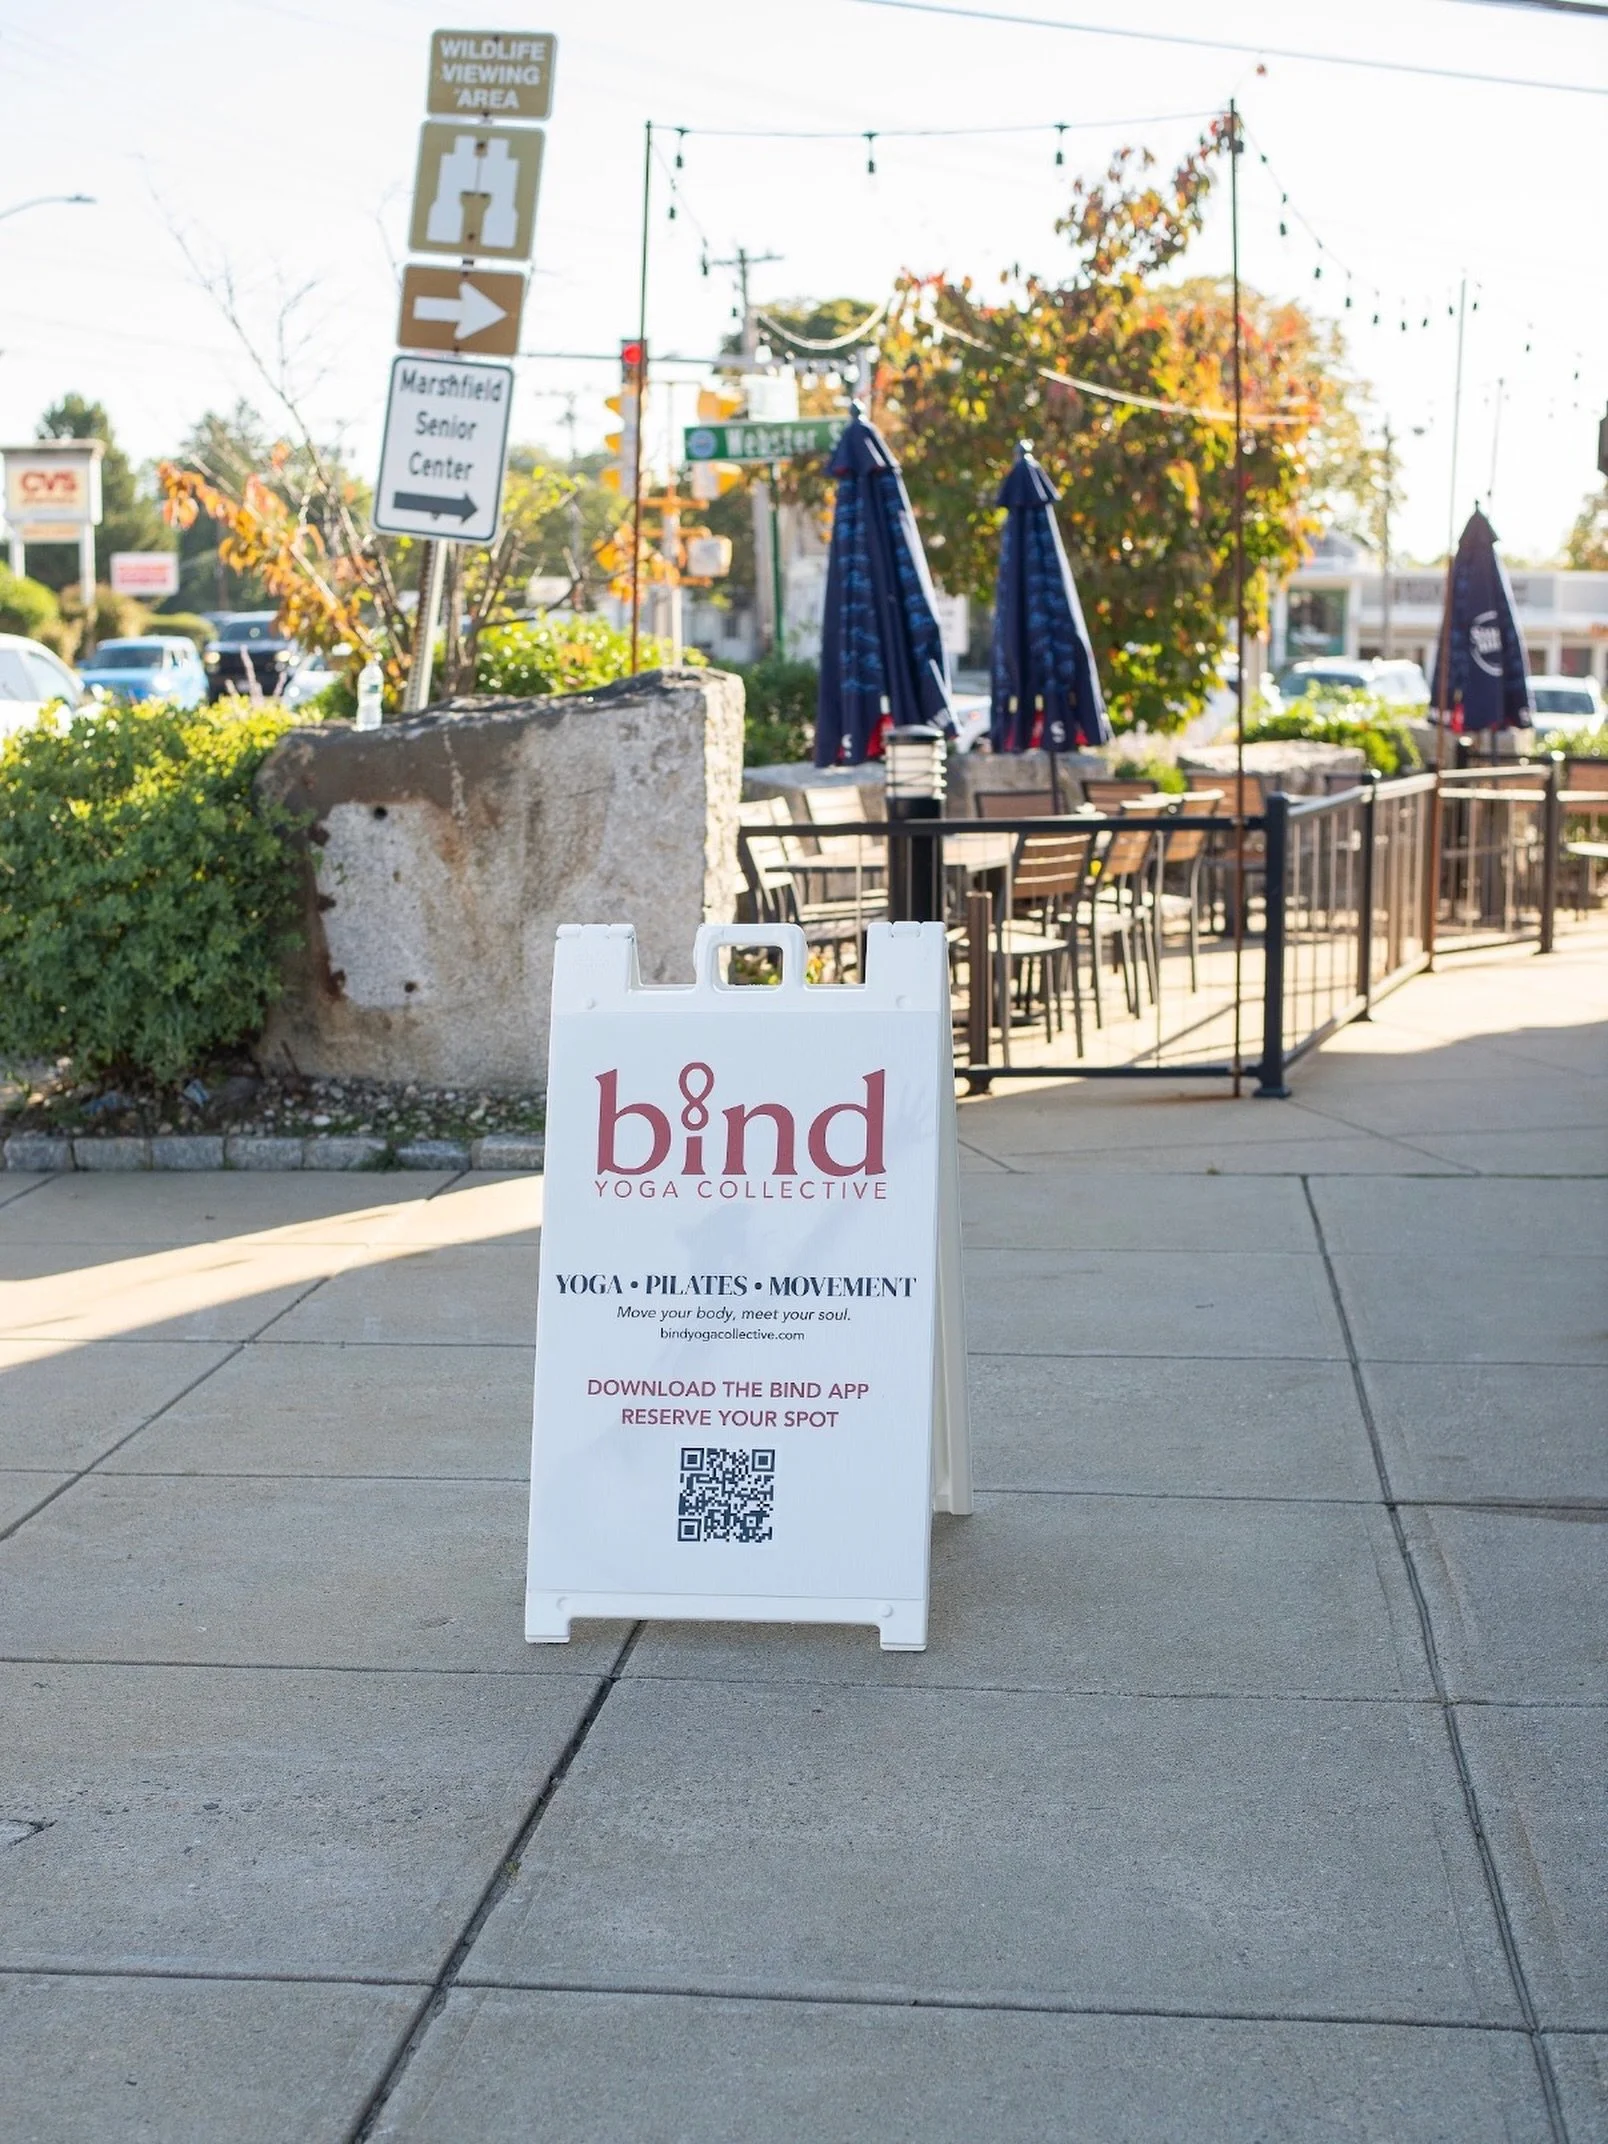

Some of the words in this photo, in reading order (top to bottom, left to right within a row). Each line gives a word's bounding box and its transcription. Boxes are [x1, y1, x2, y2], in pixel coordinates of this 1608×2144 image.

[440, 39, 546, 61] WILDLIFE
[441, 63, 540, 85] VIEWING
[456, 89, 519, 109] AREA
[401, 369, 503, 402] Marshfield
[415, 410, 477, 441] Senior
[725, 426, 816, 457] Webster
[408, 451, 475, 482] Center
[21, 470, 77, 492] CVS
[595, 1062, 887, 1177] bind
[594, 1180, 679, 1199] YOGA
[697, 1180, 887, 1200] COLLECTIVE
[556, 1274, 623, 1295] YOGA
[645, 1275, 748, 1297] PILATES
[769, 1276, 917, 1298] MOVEMENT
[616, 1306, 657, 1319] Move
[660, 1309, 692, 1323] your
[696, 1306, 736, 1323] body,
[741, 1308, 778, 1321] meet
[782, 1311, 814, 1324] your
[818, 1308, 851, 1322] soul.
[660, 1328, 805, 1342] bindyogacollective.com
[587, 1379, 717, 1398] DOWNLOAD
[722, 1381, 763, 1398] THE
[770, 1382, 822, 1399] BIND
[828, 1383, 870, 1400] APP
[621, 1408, 712, 1427] RESERVE
[718, 1410, 777, 1428] YOUR
[784, 1411, 840, 1428] SPOT
